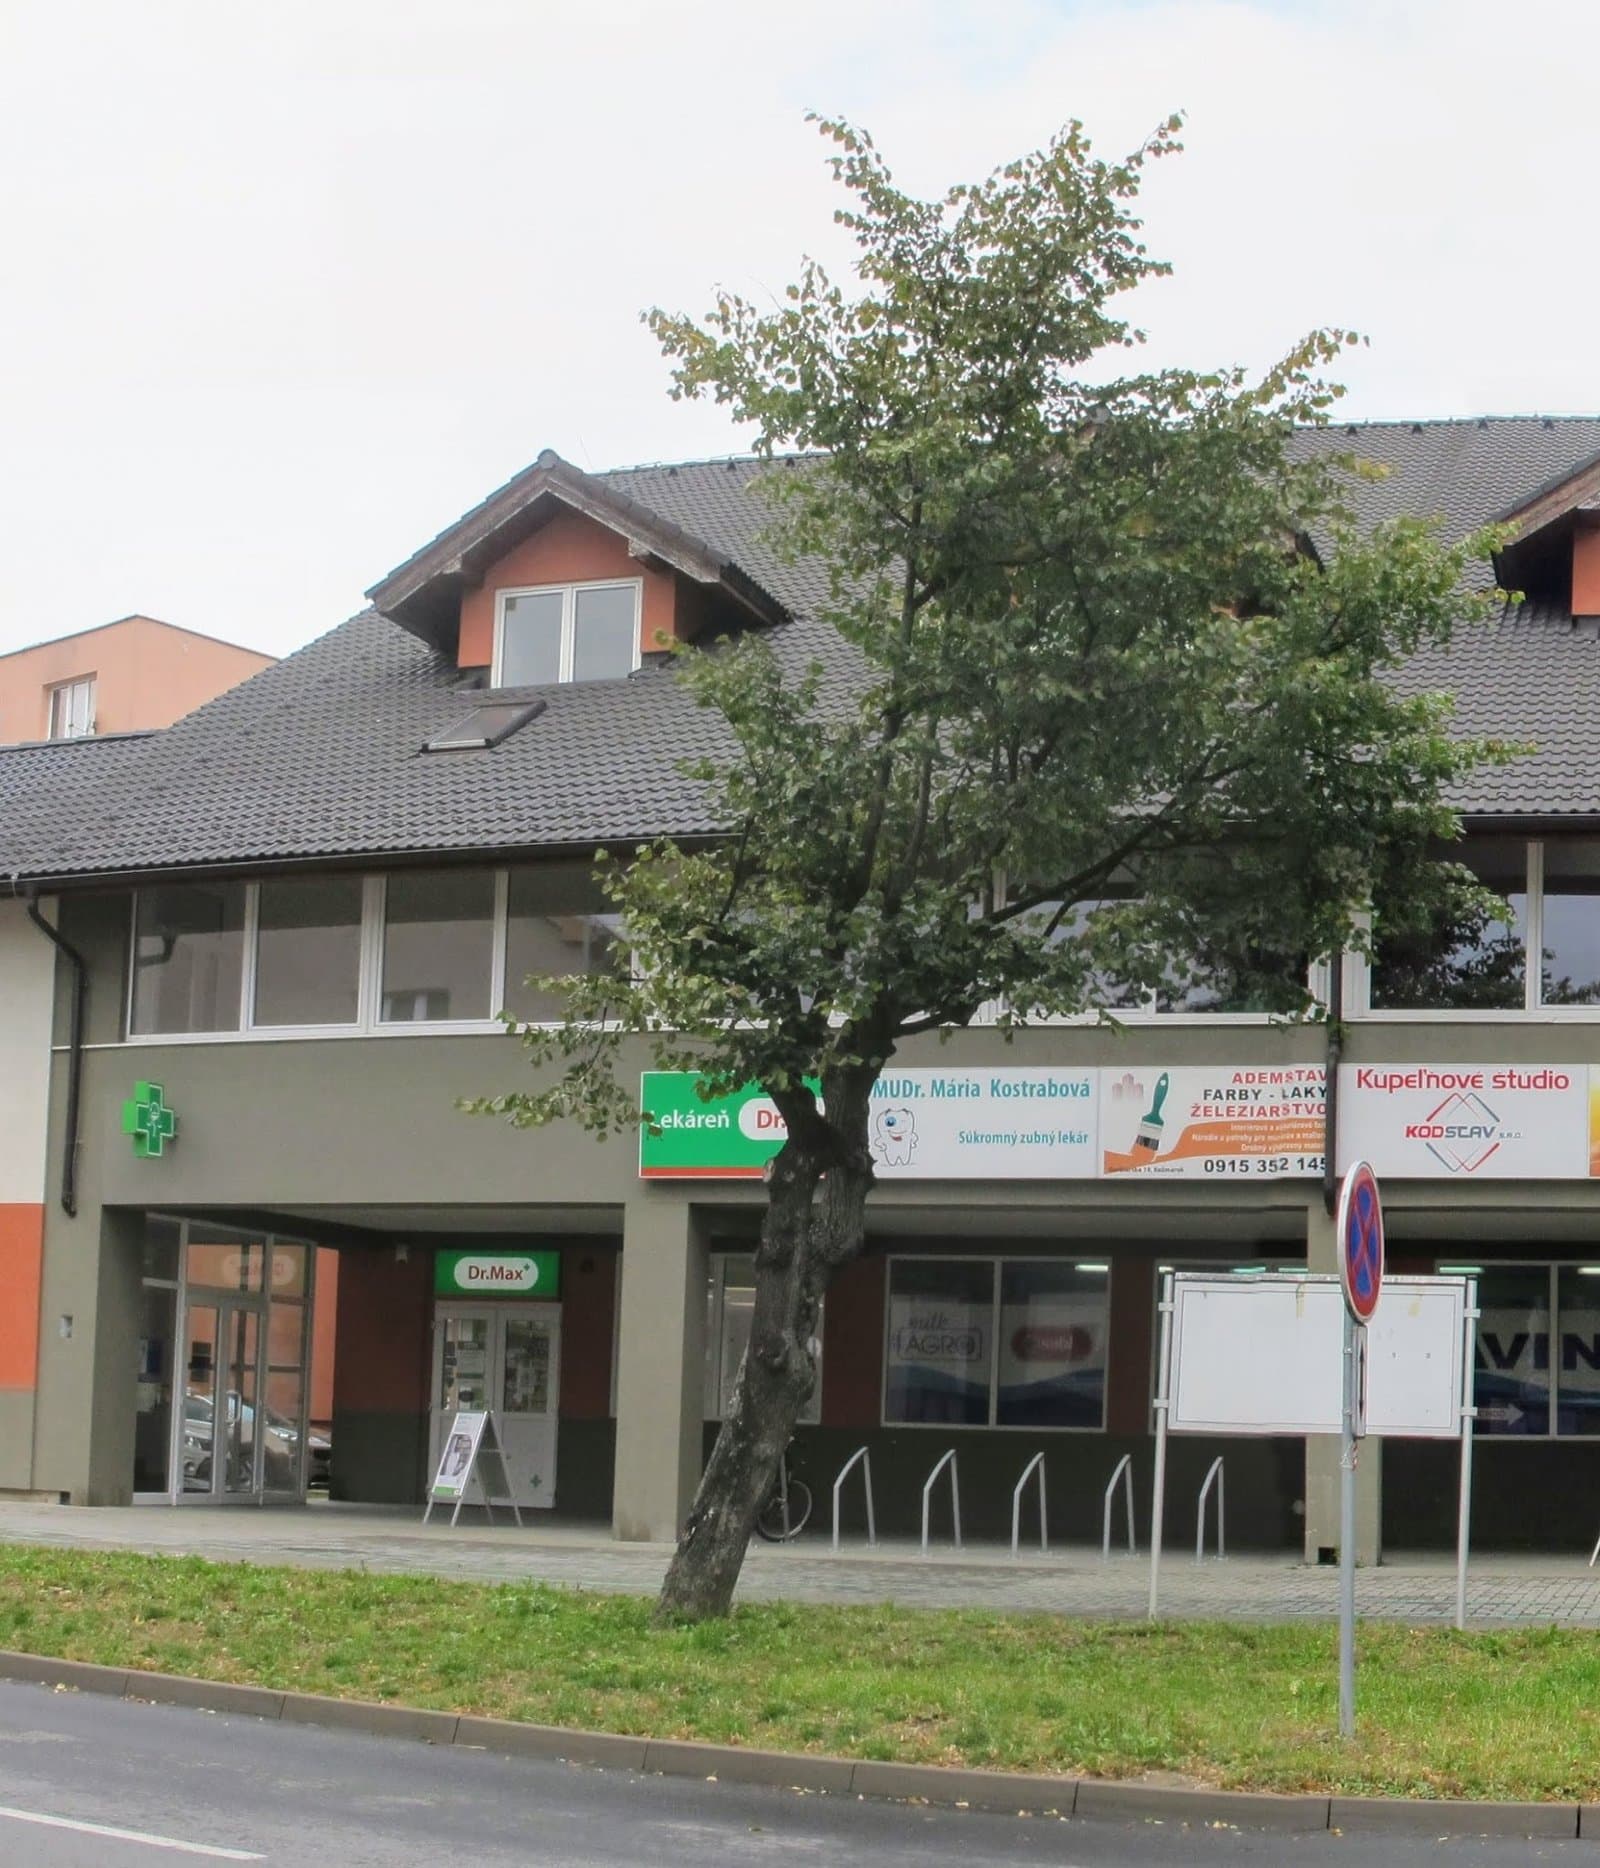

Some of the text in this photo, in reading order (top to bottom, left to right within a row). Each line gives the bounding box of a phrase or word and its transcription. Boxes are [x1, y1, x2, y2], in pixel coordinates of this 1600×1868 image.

[1231, 1069, 1327, 1084] ADEMSTAV
[872, 1077, 1090, 1098] MUDr. Mária Kostrabová
[1203, 1089, 1262, 1101] FARBY
[1281, 1086, 1327, 1099] LAKY
[1189, 1102, 1327, 1118] ŽELEZIARSTVO
[958, 1130, 1089, 1147] Súkromný zubný lekár
[1203, 1159, 1250, 1174] 0915
[1256, 1157, 1289, 1174] 352
[468, 1264, 523, 1282] Dr.Max
[1475, 1332, 1600, 1371] VIN
